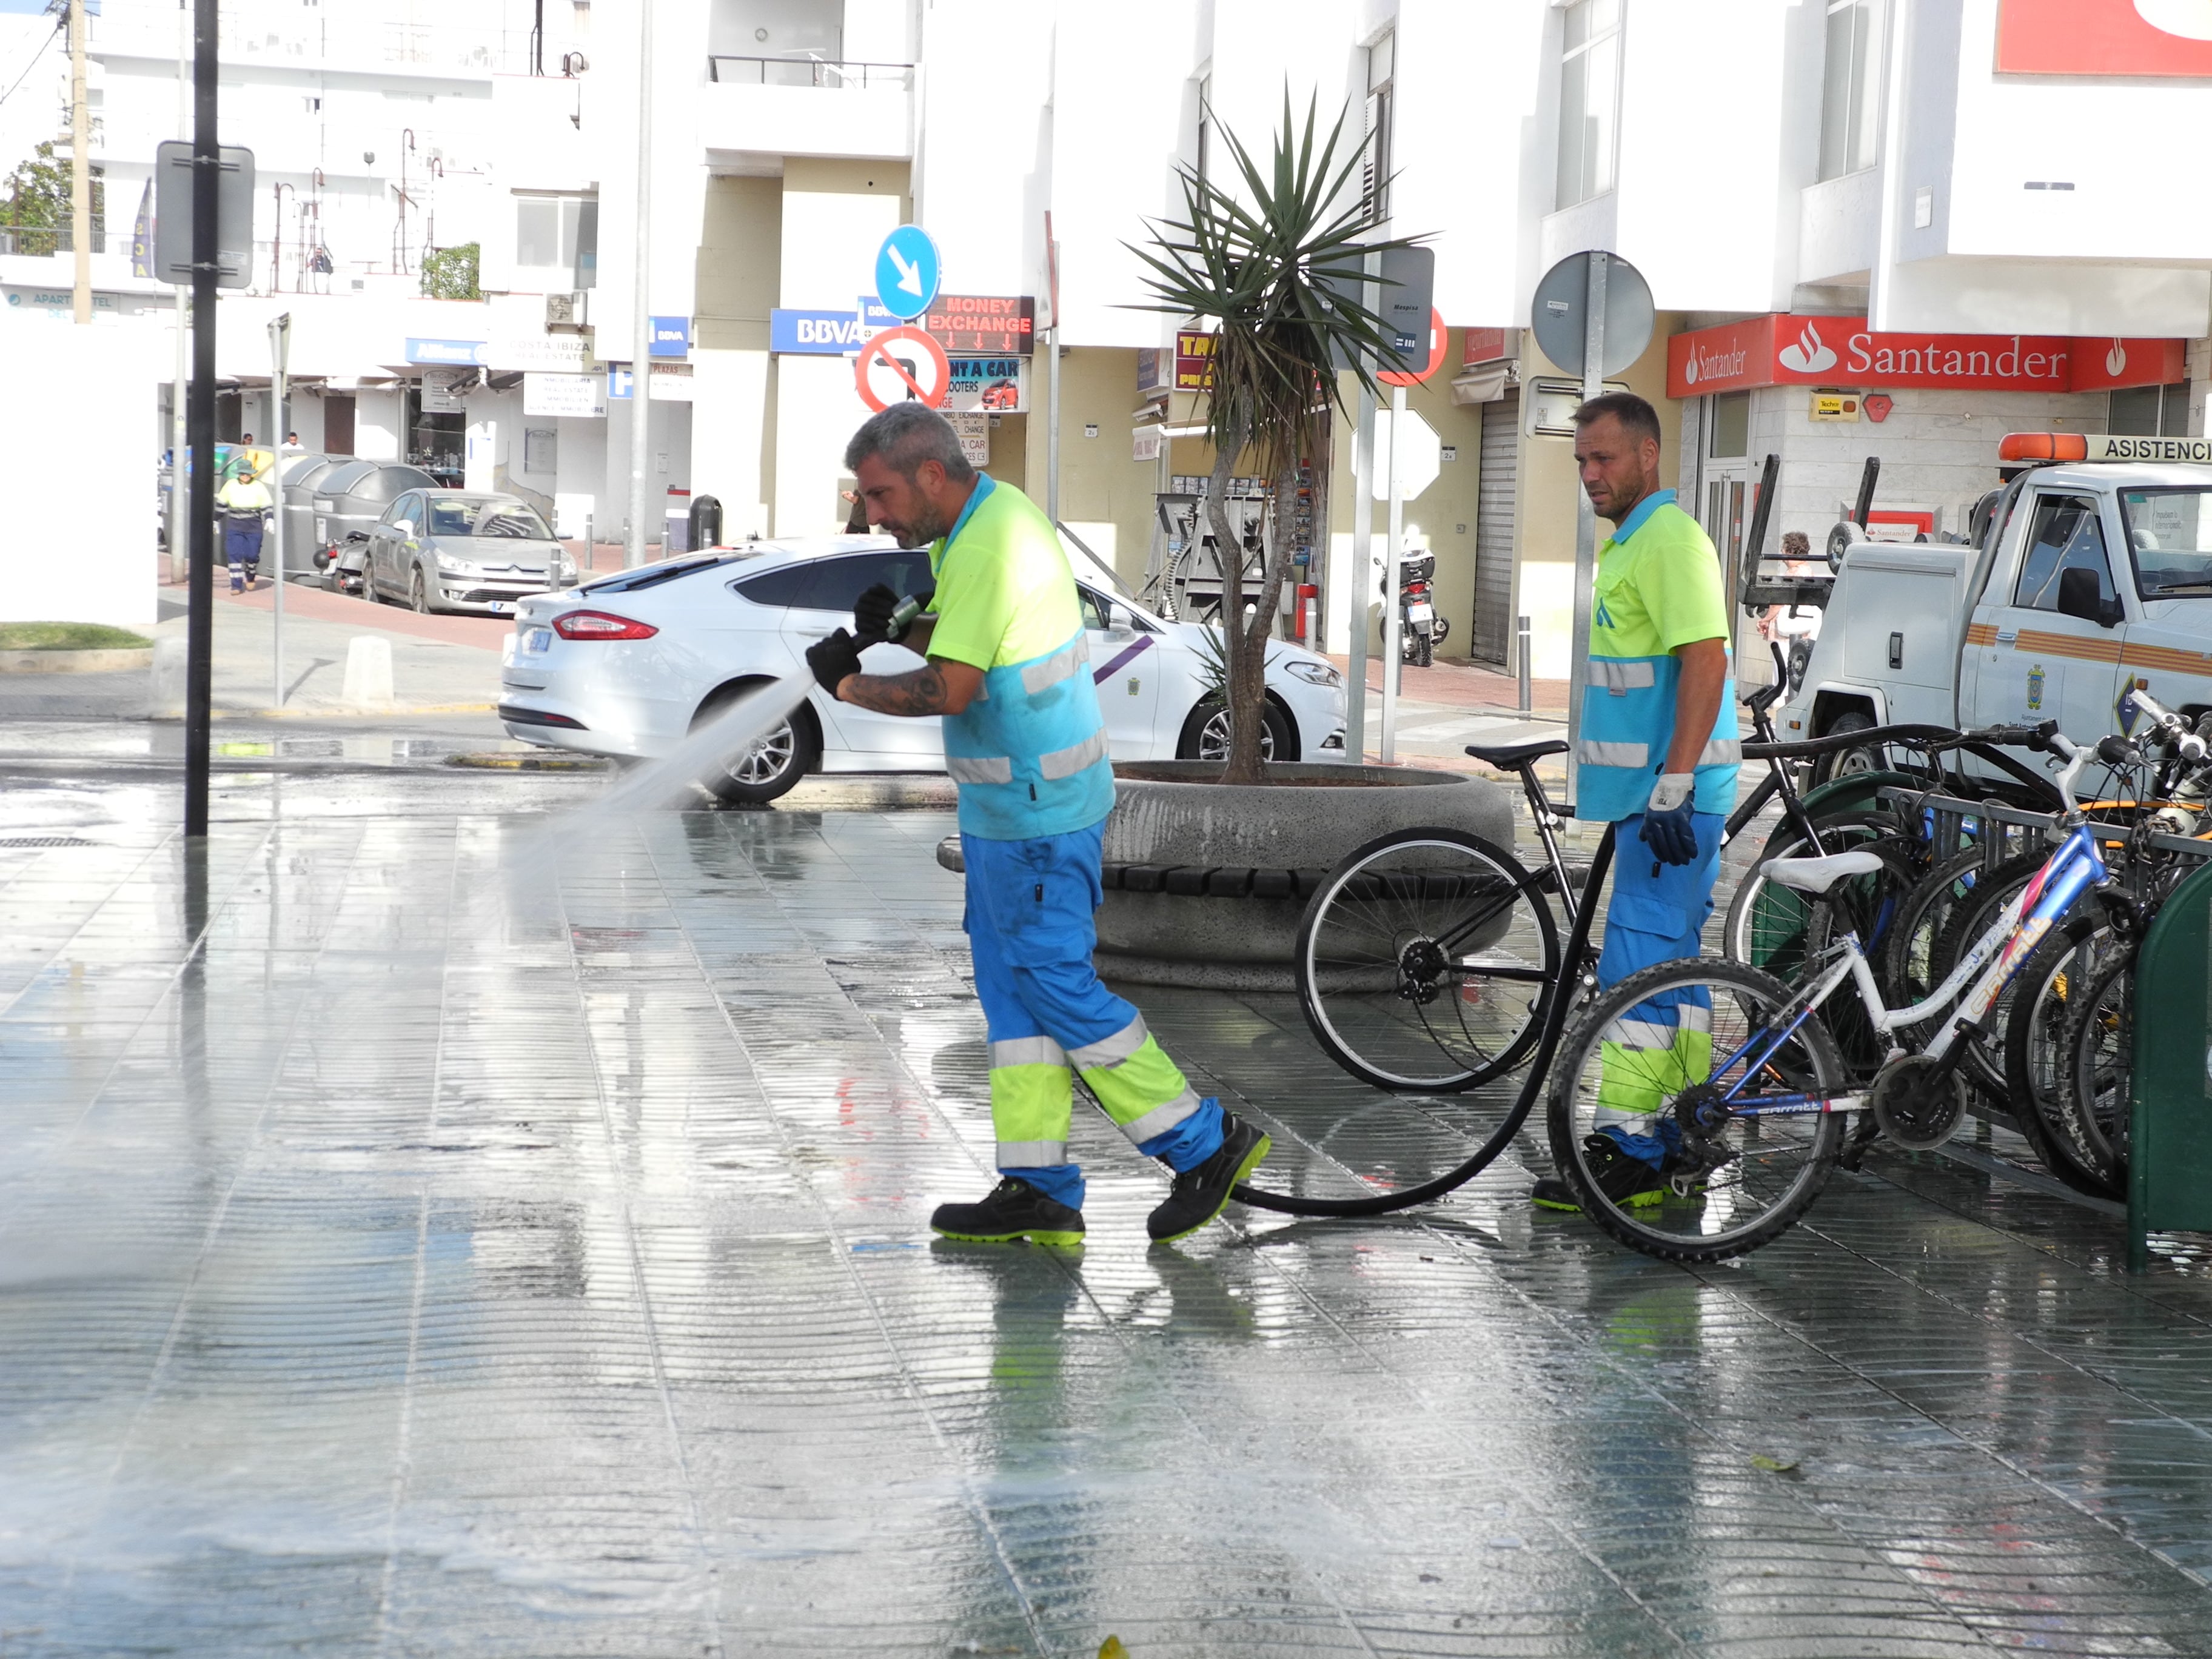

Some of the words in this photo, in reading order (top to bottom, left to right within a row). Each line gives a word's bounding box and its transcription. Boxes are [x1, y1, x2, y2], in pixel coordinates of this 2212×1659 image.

[33, 294, 71, 305] APART
[92, 297, 112, 307] TEL
[947, 297, 1014, 313] MONEY
[48, 310, 68, 320] DEL
[797, 319, 867, 344] BBVA
[928, 315, 1031, 332] EXCHANGE
[658, 330, 683, 341] BBVA
[510, 341, 551, 350] COSTA
[557, 343, 590, 352] IBIZA
[1699, 336, 1746, 381] Santander
[1847, 333, 2066, 378] Santander
[971, 362, 982, 377] A
[987, 361, 1018, 377] CAR
[970, 440, 985, 449] CAR
[2105, 440, 2212, 460] ASISTENCI
[1877, 529, 1911, 537] Santander
